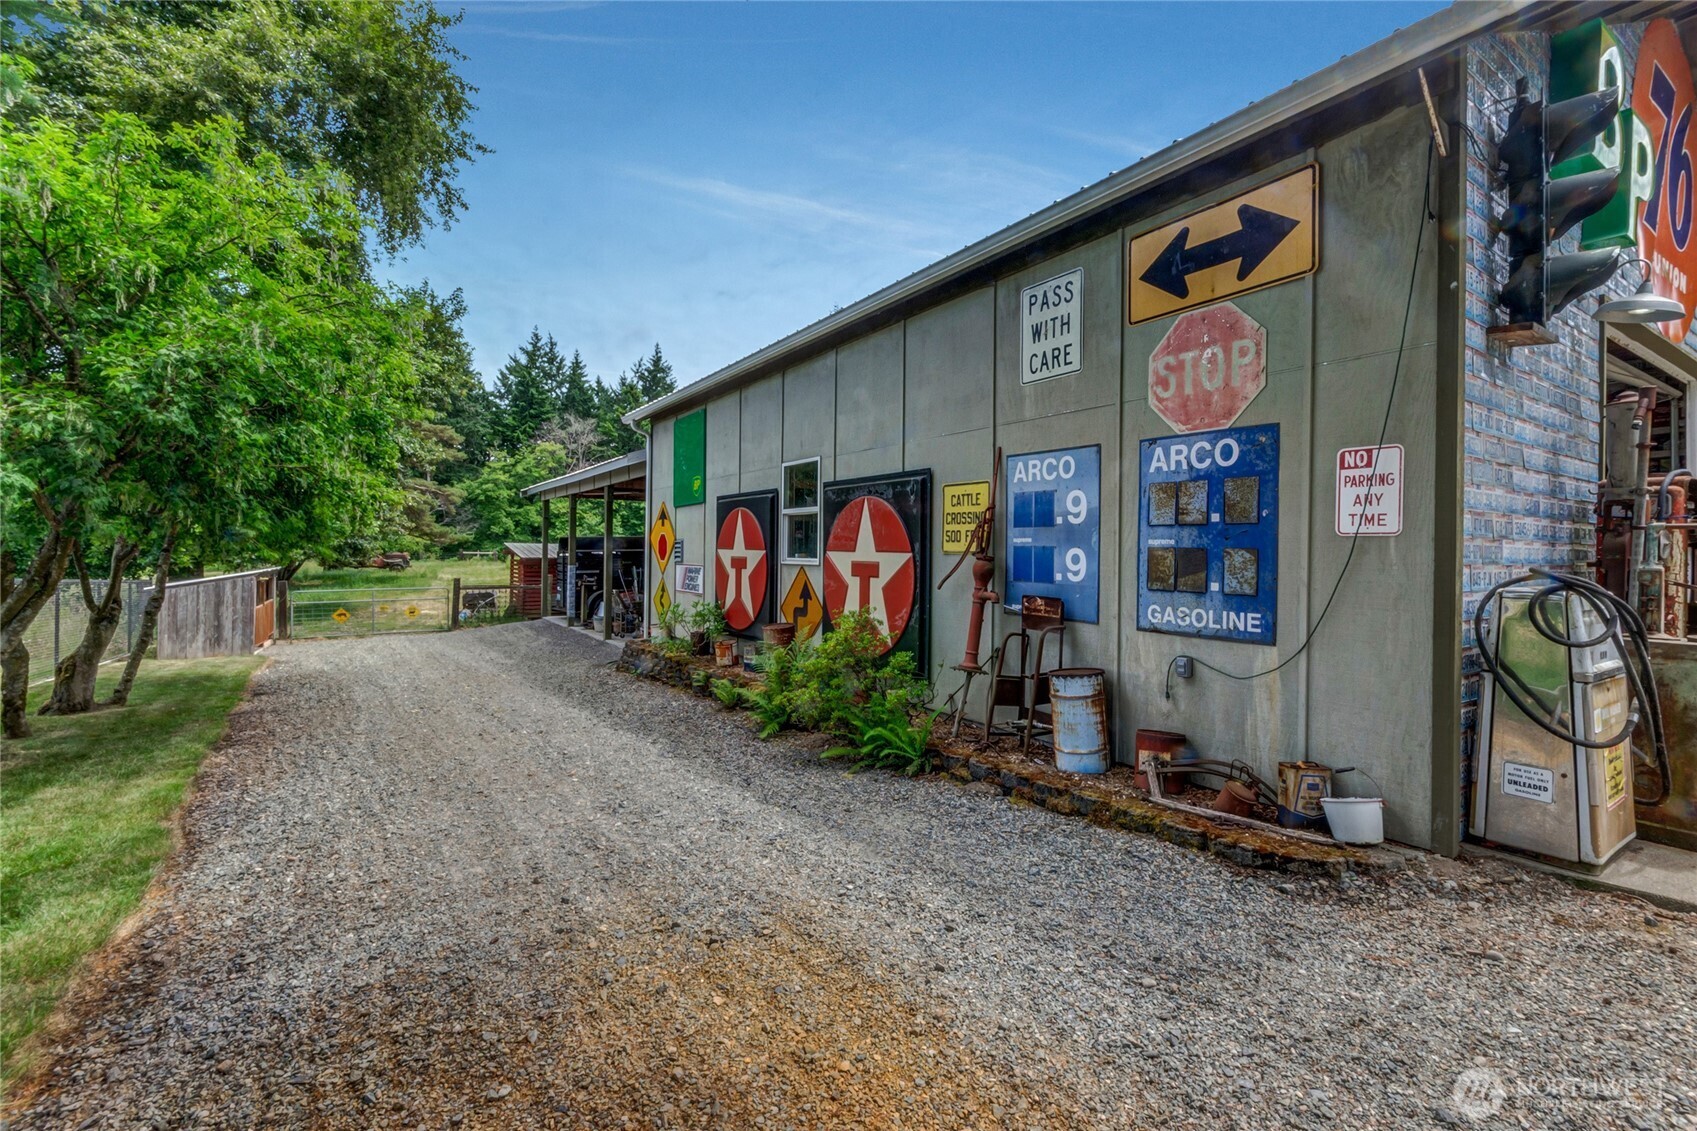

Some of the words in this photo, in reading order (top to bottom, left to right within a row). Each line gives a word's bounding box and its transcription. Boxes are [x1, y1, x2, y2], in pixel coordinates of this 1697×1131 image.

[1642, 59, 1694, 252] 76
[1653, 252, 1687, 293] UNION
[1028, 280, 1075, 316] PASS
[1031, 313, 1071, 345] WITH
[1029, 344, 1073, 376] CARE
[1155, 338, 1258, 400] STOP
[1149, 437, 1240, 473] ARCO
[1343, 450, 1369, 468] NO
[1013, 455, 1076, 484] ARCO
[1344, 472, 1395, 487] PARKING
[950, 492, 981, 507] CATTLE
[1353, 493, 1384, 507] ANY
[1348, 513, 1388, 527] TIME
[945, 530, 962, 543] 500
[1148, 537, 1175, 546] supreme
[1147, 605, 1262, 634] GASOLINE
[1507, 778, 1549, 792] UNLEADED
[1515, 788, 1541, 798] GASOLINE
